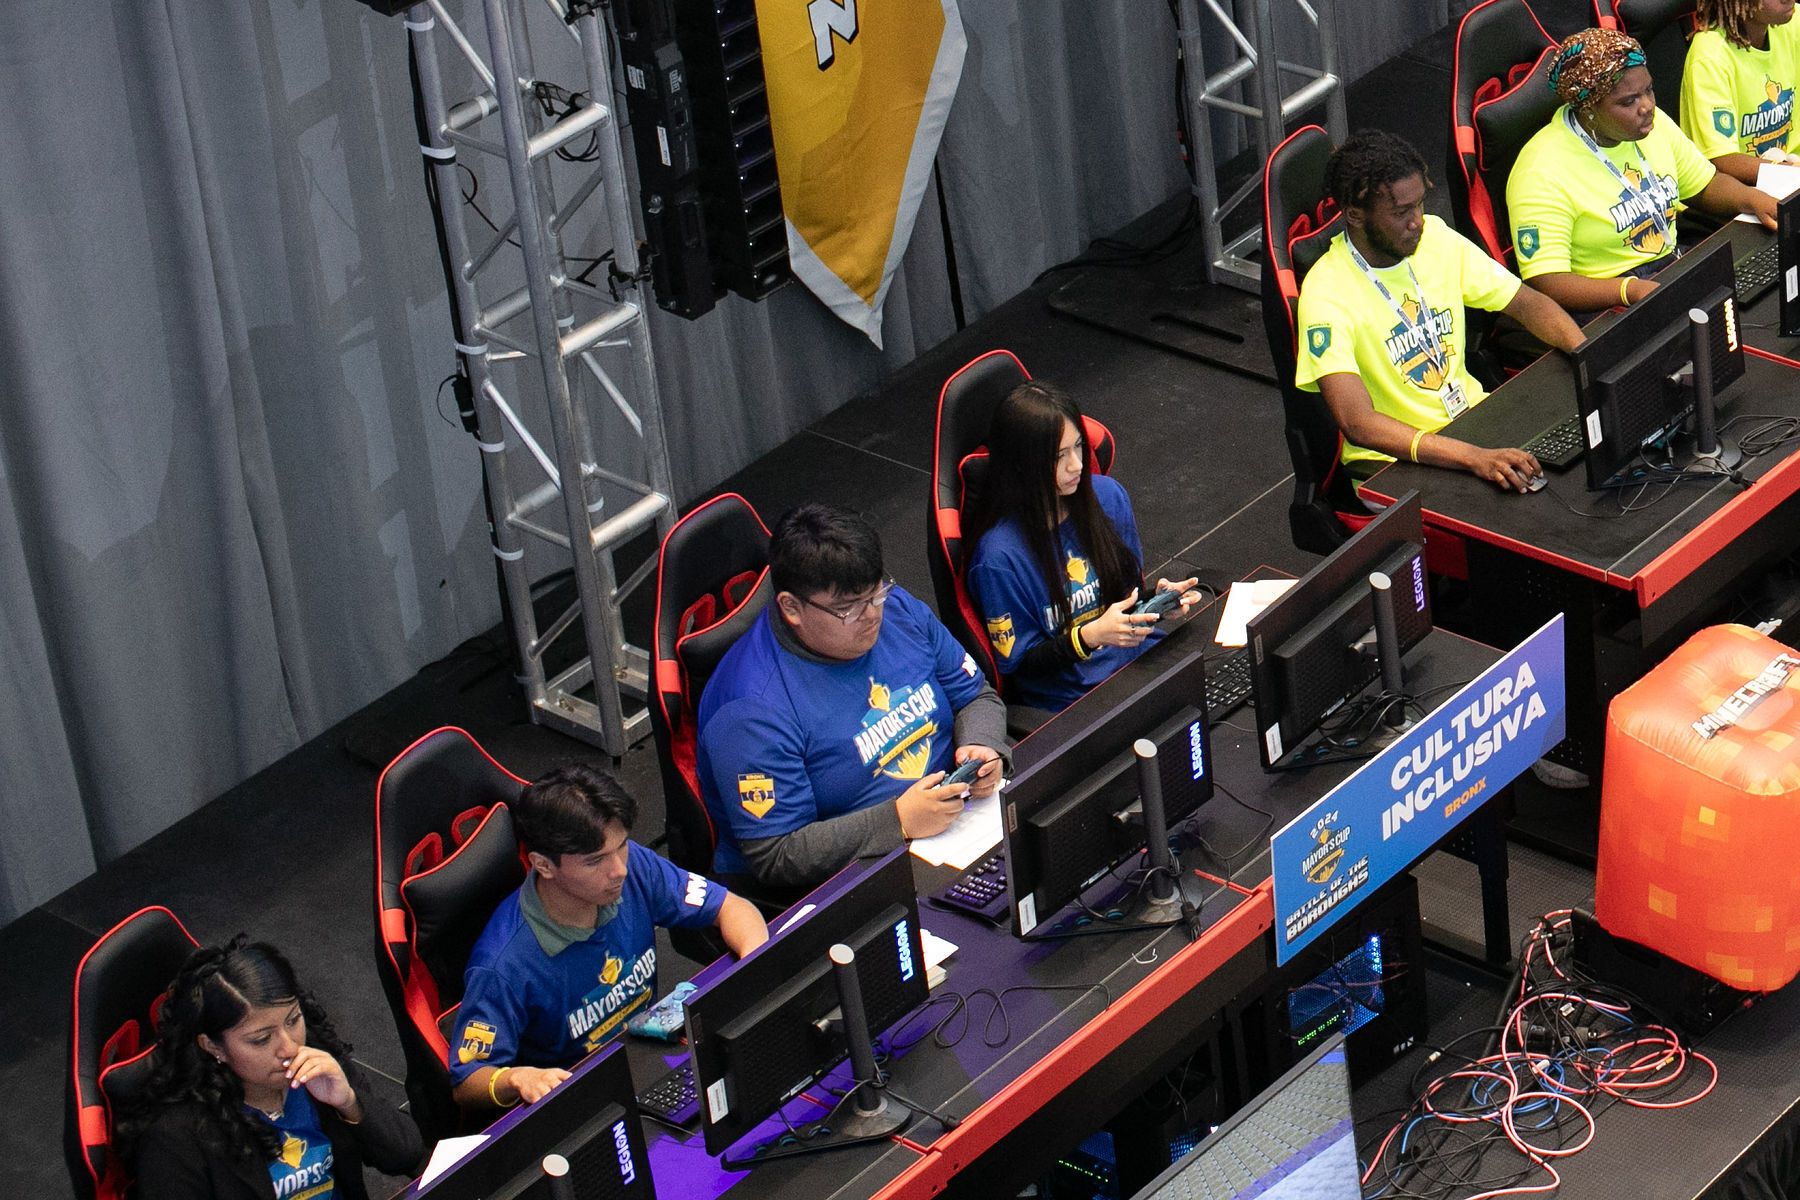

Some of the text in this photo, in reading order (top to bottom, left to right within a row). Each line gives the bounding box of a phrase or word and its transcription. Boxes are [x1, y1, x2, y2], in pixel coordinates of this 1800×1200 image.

[1412, 556, 1425, 612] LEGION
[854, 702, 916, 764] MAYOR'S
[908, 683, 937, 717] CUP
[1190, 721, 1204, 780] LEGION
[1391, 662, 1537, 791] CULTURA
[1382, 692, 1547, 842] INCLUSIVA
[1444, 776, 1488, 818] BRONX
[1302, 826, 1351, 875] MAYOR'S CUP
[1310, 810, 1339, 839] 2024
[1286, 855, 1369, 927] BATTLE OF THE
[1286, 867, 1370, 944] BOROUGHS
[894, 921, 914, 982] LEGION
[568, 974, 637, 1039] MAYOR'S
[632, 948, 656, 986] CUP
[273, 1162, 322, 1200] YOR'S
[612, 1121, 636, 1186] LEGION
